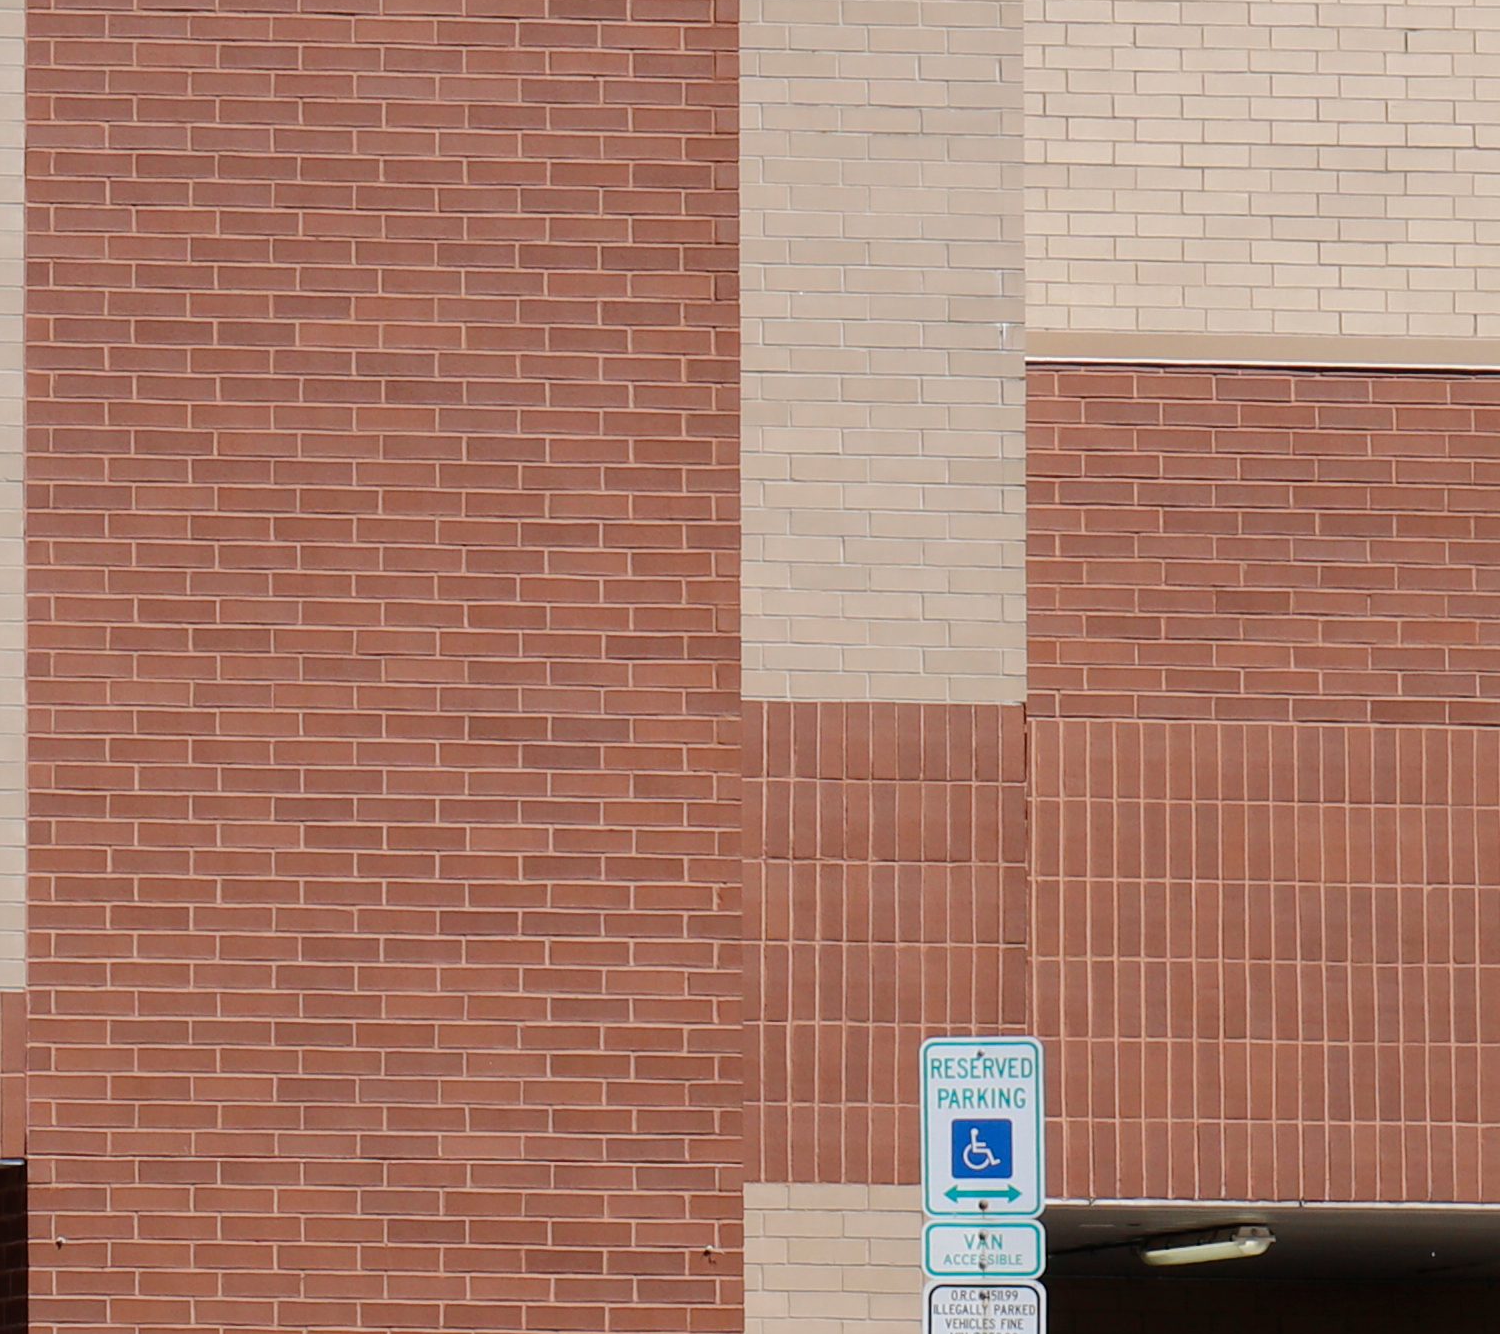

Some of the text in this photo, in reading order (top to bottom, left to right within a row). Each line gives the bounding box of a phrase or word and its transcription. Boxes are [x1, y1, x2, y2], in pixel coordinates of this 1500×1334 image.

[930, 1057, 1034, 1079] RESERVED
[937, 1087, 1027, 1109] PARKING
[963, 1233, 1004, 1250] VAN
[943, 1253, 1024, 1266] ACCESSIBLE
[933, 1304, 1036, 1316] ILLEGALLY PARKED
[945, 1318, 1024, 1330] VEHICLES FINE
